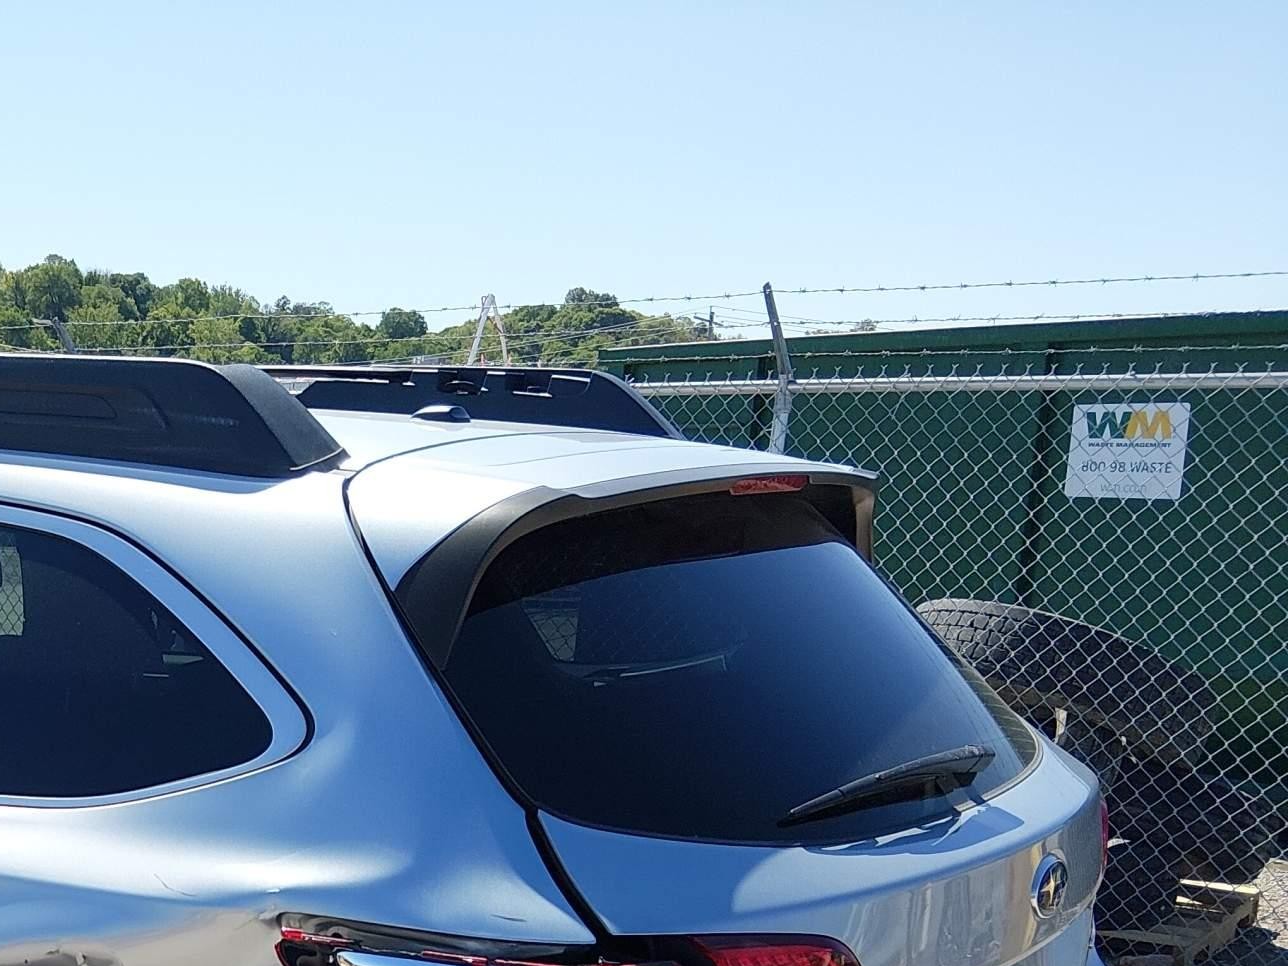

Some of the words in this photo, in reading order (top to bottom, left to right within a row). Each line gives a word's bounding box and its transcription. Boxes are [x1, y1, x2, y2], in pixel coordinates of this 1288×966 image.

[1086, 410, 1172, 439] WM
[1110, 461, 1126, 473] 98
[1128, 461, 1173, 474] WASTE
